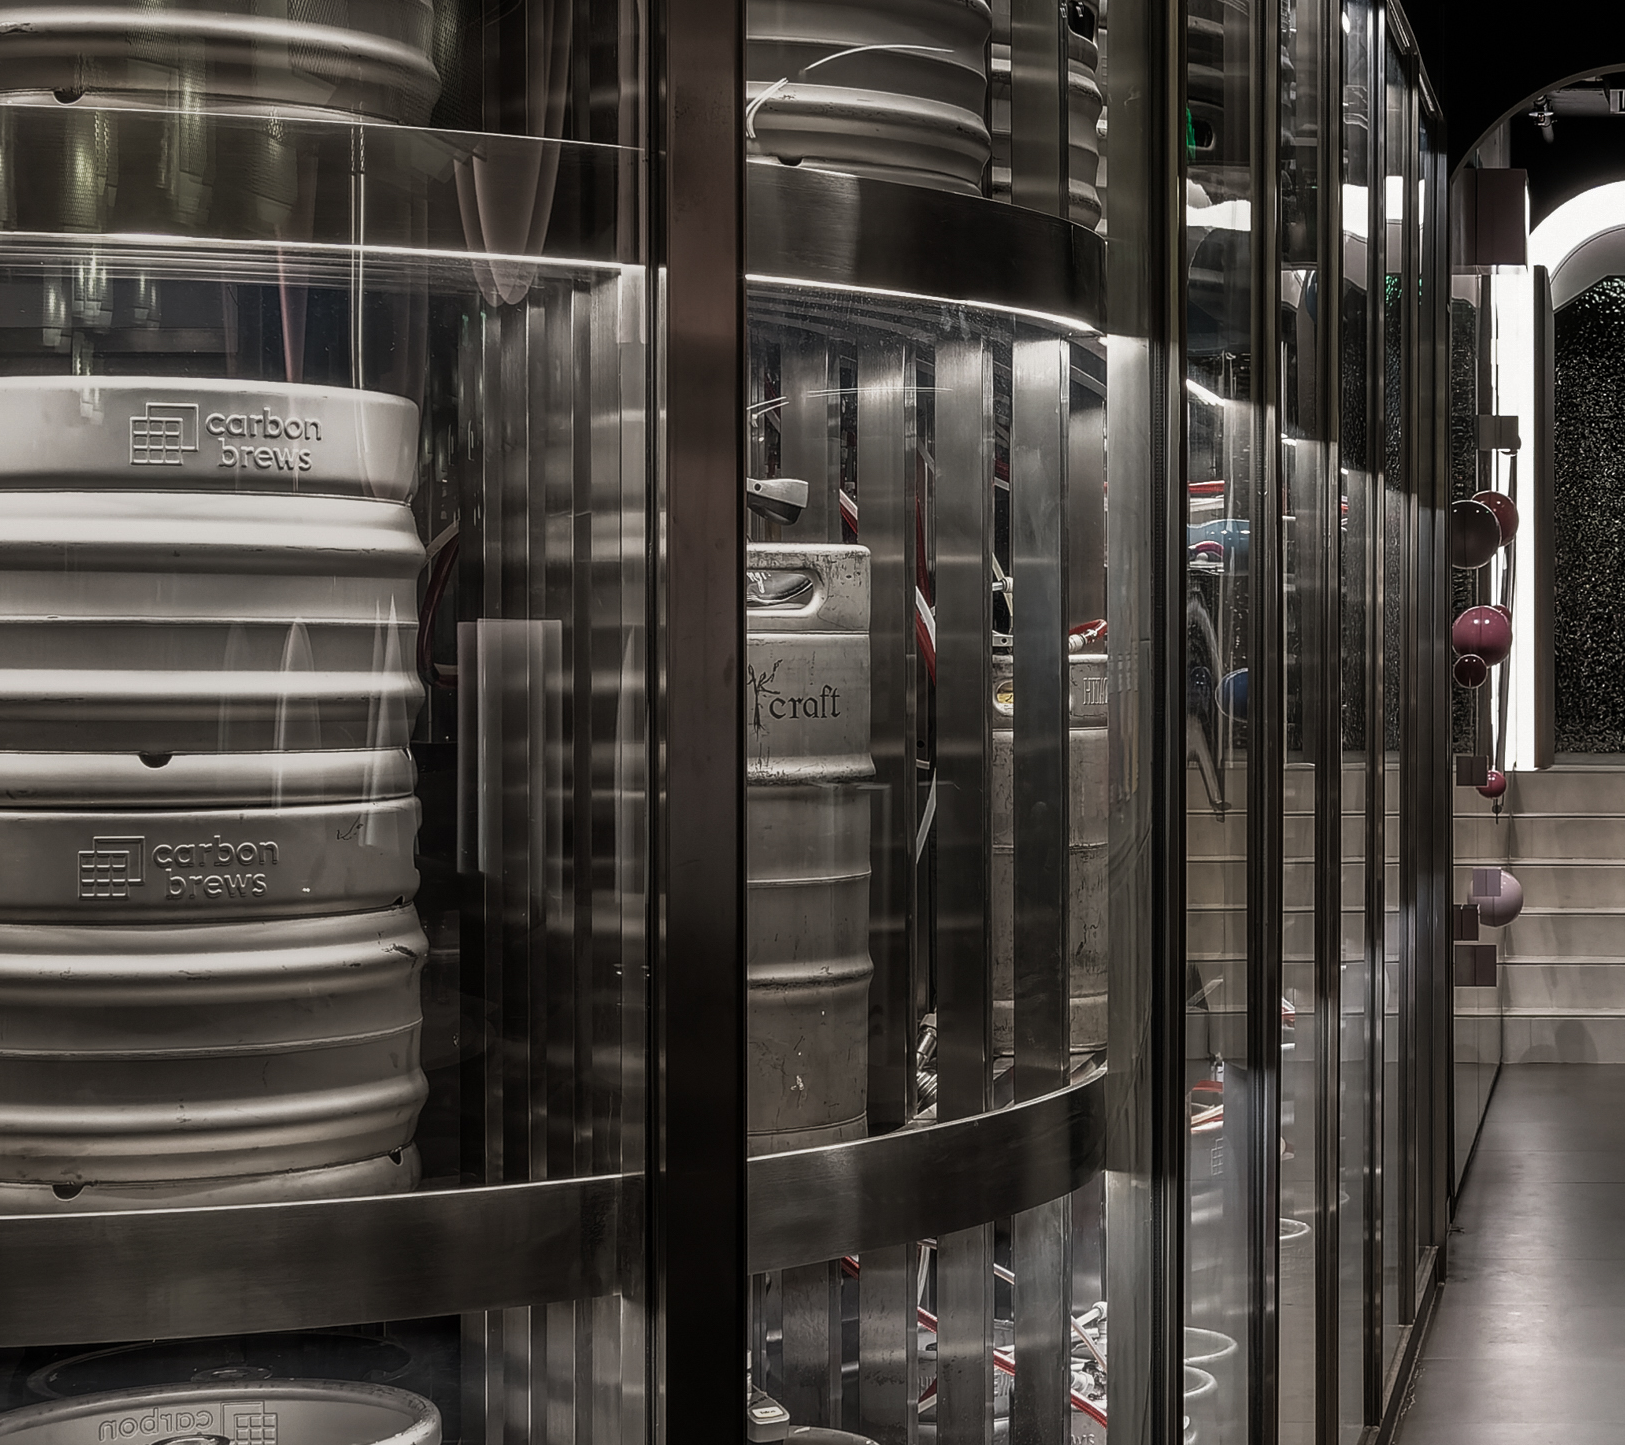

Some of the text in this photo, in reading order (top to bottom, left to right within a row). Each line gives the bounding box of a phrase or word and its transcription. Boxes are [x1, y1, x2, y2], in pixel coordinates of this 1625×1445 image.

[205, 407, 322, 441] carbon
[217, 437, 312, 471] brews
[769, 684, 841, 719] craft
[152, 834, 280, 867] carbon
[164, 868, 267, 900] brews
